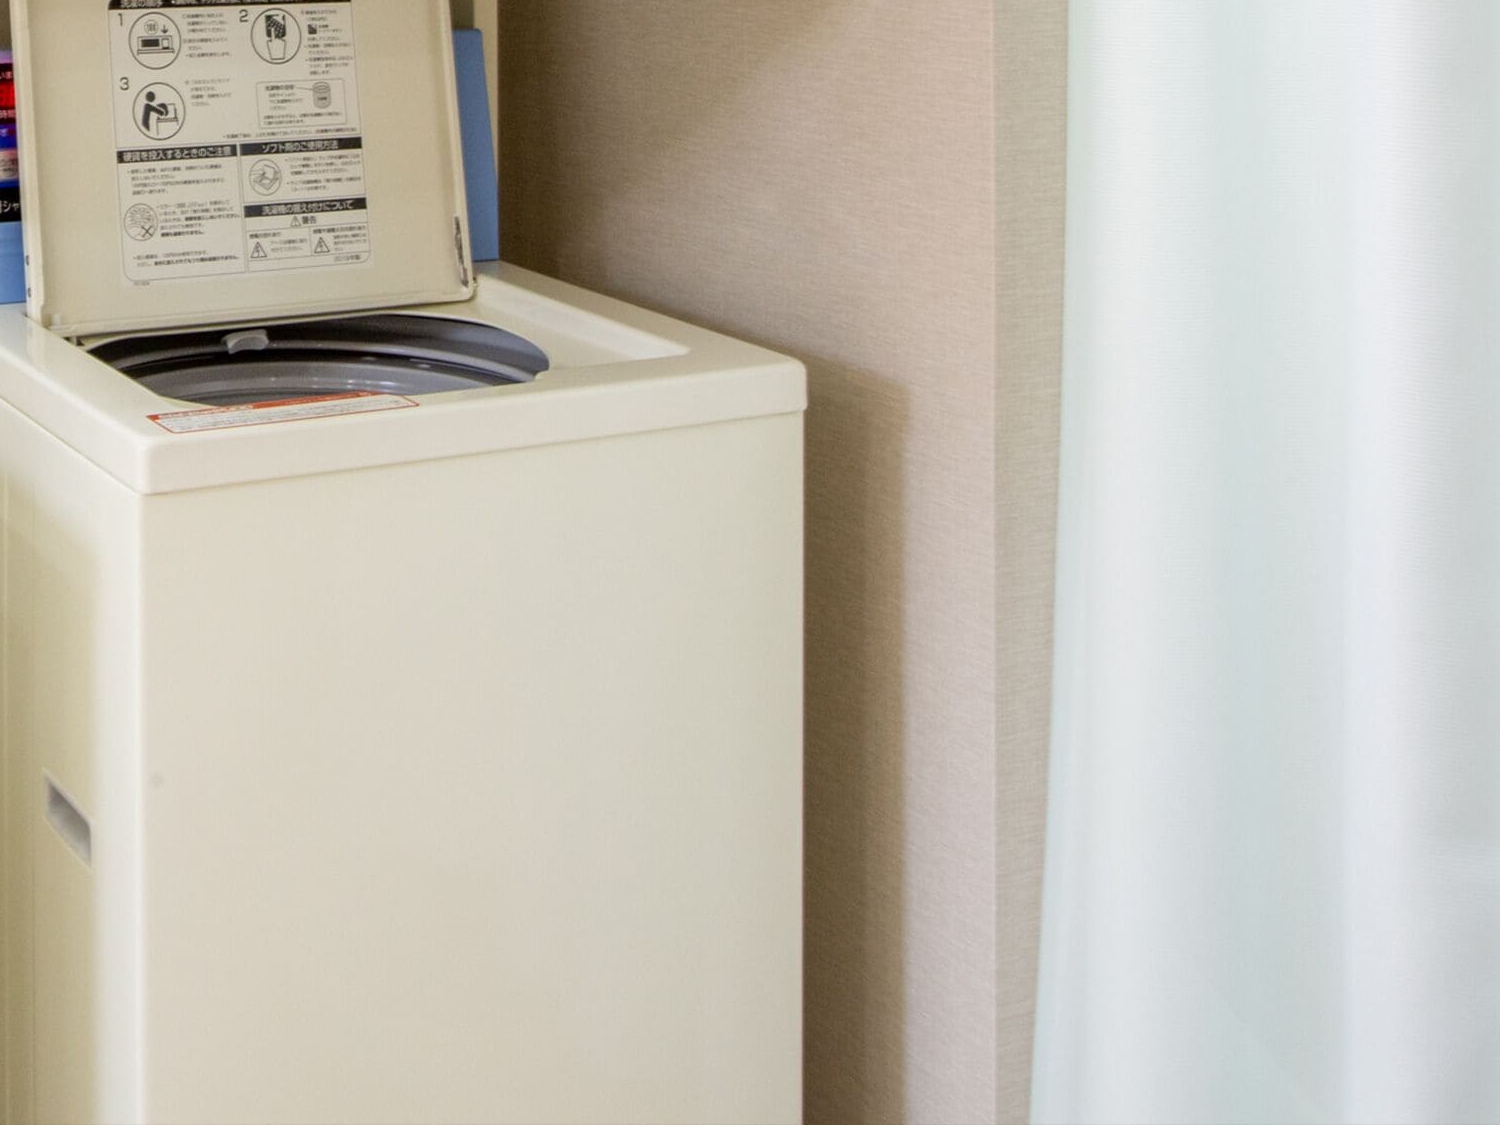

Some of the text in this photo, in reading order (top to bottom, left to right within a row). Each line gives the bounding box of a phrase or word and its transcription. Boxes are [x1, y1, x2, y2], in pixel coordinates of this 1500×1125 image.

[117, 13, 124, 26] 1
[239, 10, 248, 23] 2
[119, 77, 130, 91] 3
[302, 216, 316, 224] 警告
